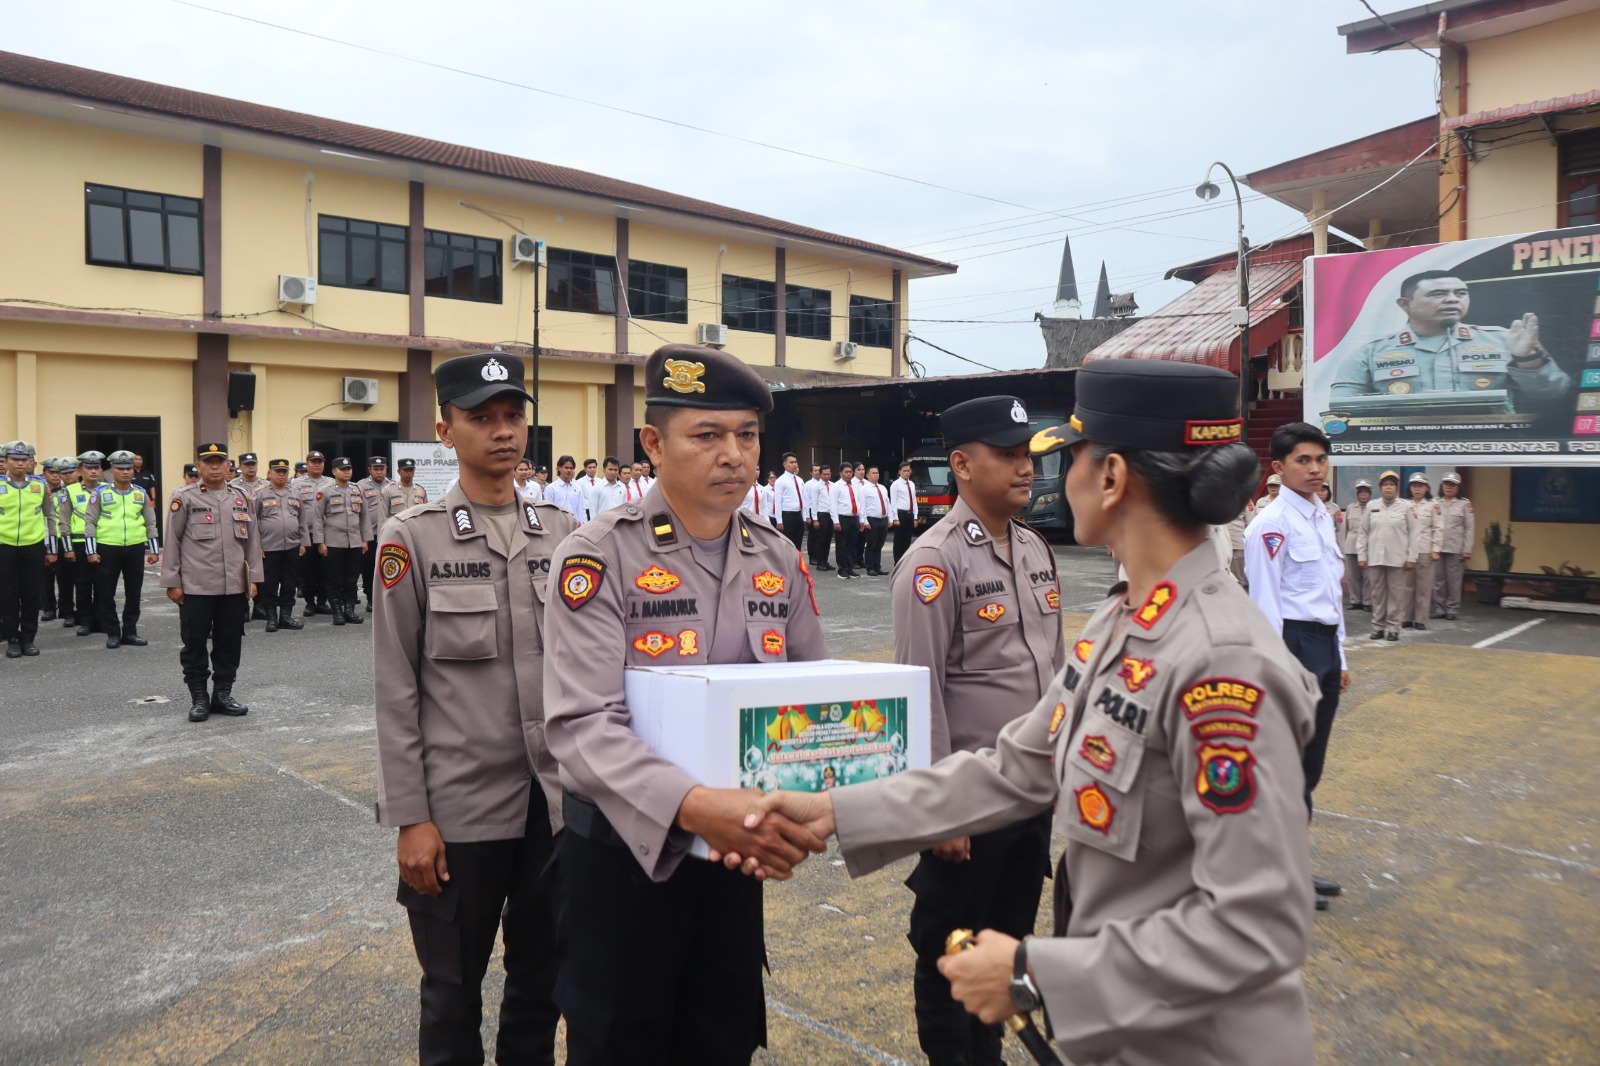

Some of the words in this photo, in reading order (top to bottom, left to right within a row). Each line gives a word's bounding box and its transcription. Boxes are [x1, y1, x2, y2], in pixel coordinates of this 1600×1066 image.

[1376, 358, 1415, 369] WHISNU
[1462, 353, 1502, 361] POLRI
[1331, 442, 1394, 453] POLRES
[1395, 441, 1560, 453] PEMATANGSIANTAR
[430, 562, 491, 579] A.S.LUBIS
[965, 586, 975, 599] A.
[630, 601, 639, 619] J.
[748, 600, 789, 619] POLRI
[1183, 682, 1259, 707] POLRES
[1094, 686, 1148, 735] POLRI
